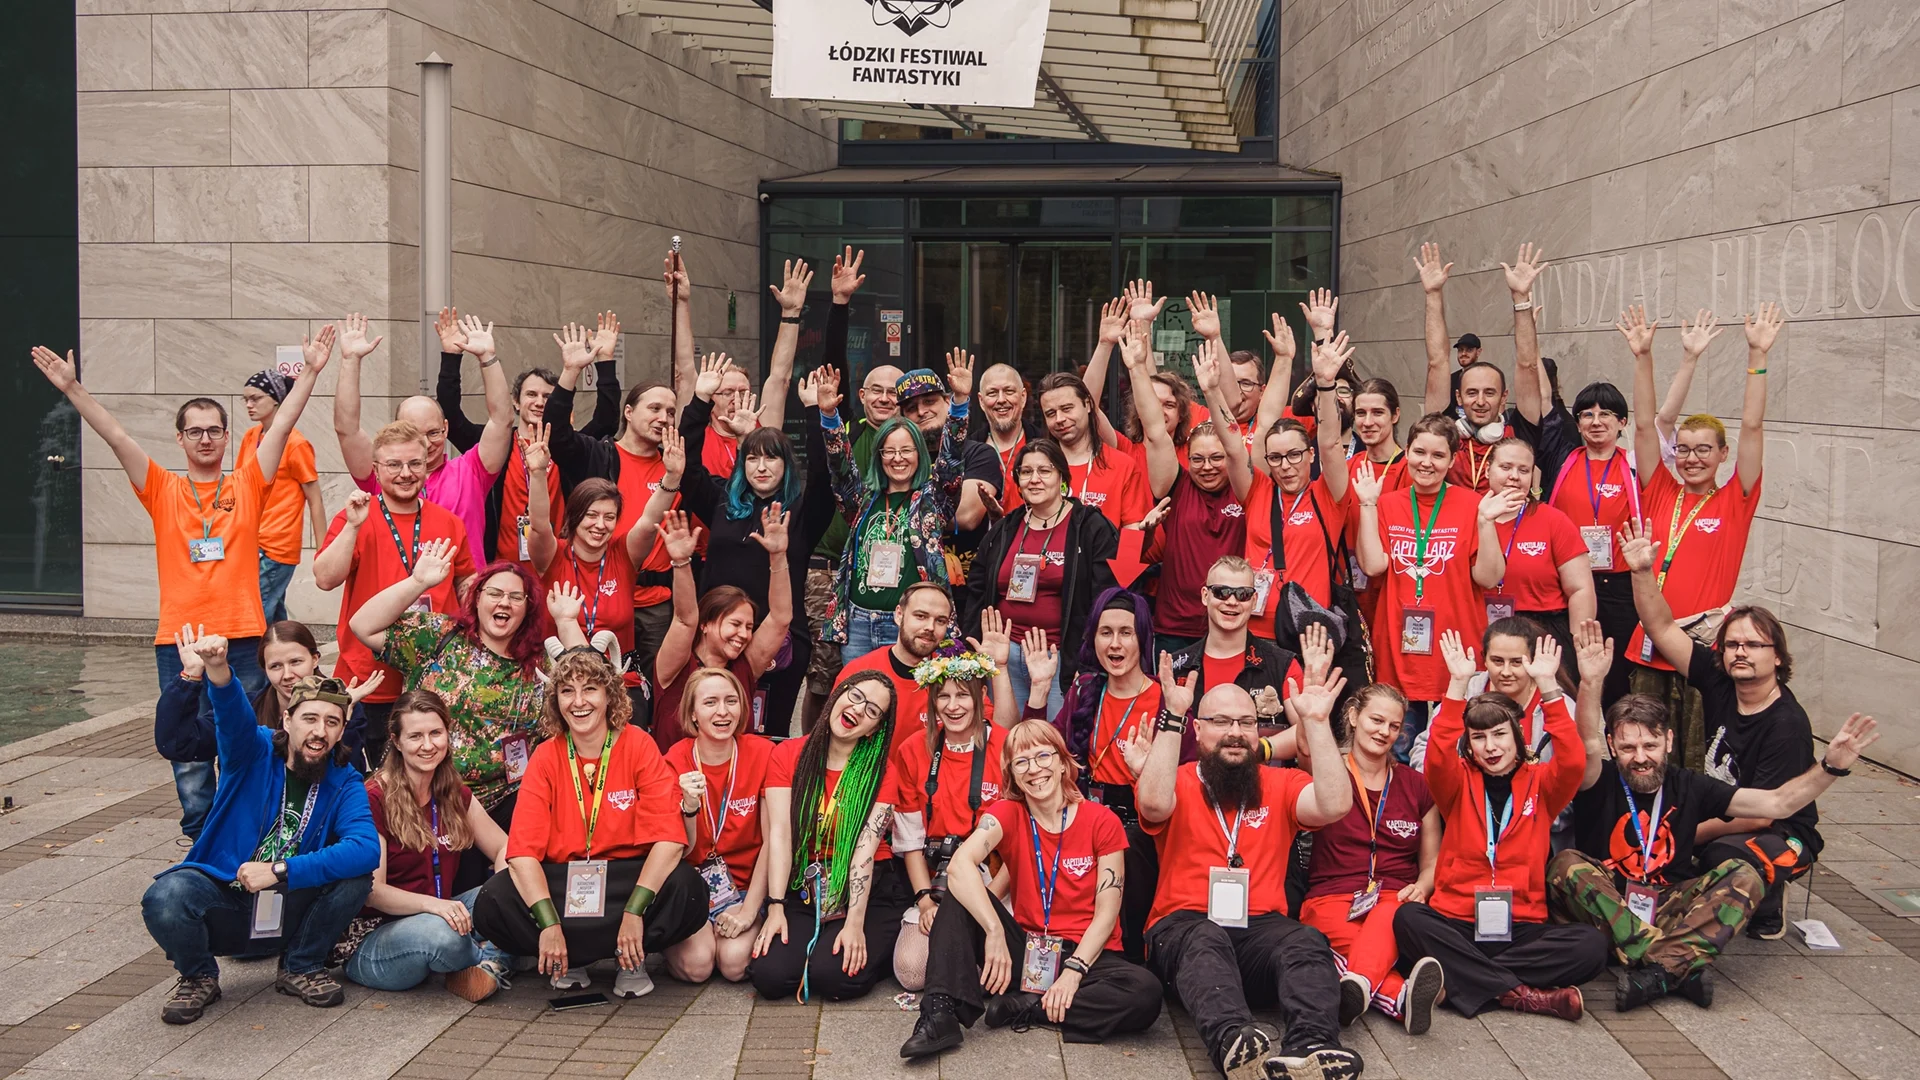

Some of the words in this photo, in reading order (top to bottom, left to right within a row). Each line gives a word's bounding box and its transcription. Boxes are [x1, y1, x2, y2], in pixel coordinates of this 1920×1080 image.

[828, 41, 895, 63] ŁÓDZKI
[900, 48, 988, 67] FESTIWAL
[852, 67, 961, 86] FANTASTYKI
[897, 378, 911, 396] PLUS
[1390, 539, 1457, 560] APITLARZ
[930, 751, 941, 776] Canon
